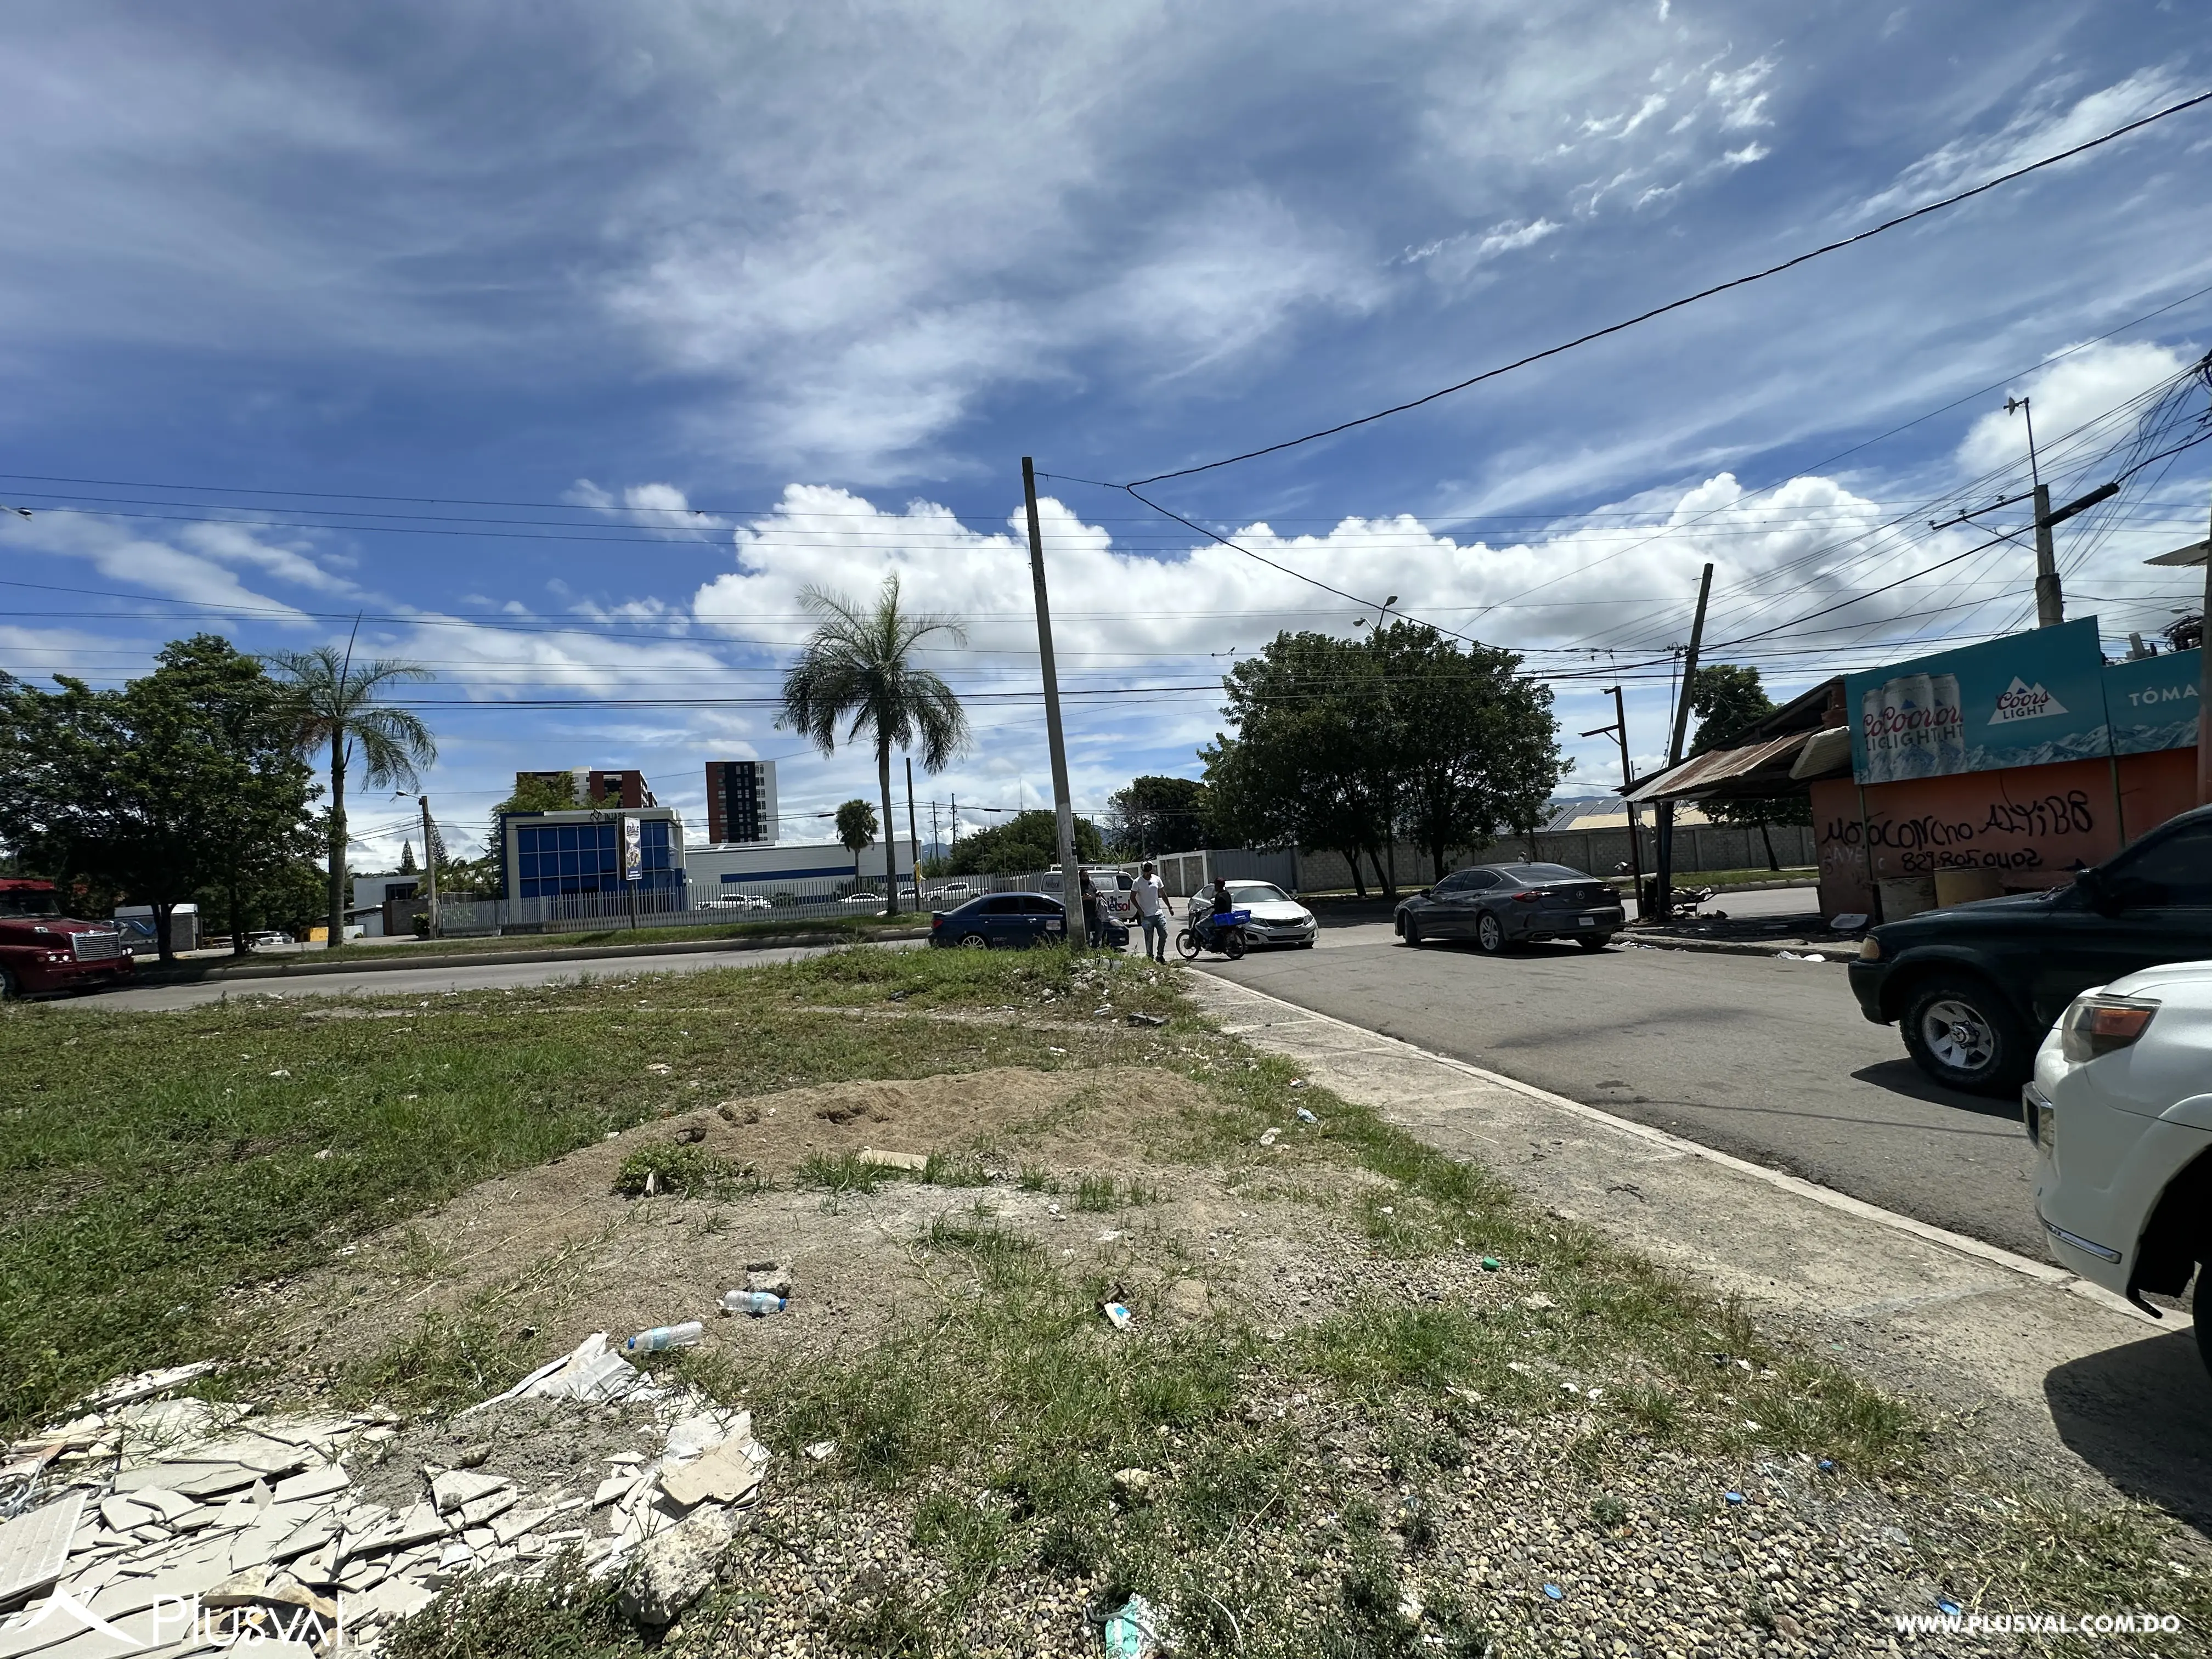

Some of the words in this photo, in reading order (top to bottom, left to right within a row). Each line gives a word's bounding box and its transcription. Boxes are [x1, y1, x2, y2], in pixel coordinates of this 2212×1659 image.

[1996, 690, 2051, 710] Coors
[2129, 684, 2199, 707] TÓMA
[2003, 704, 2045, 719] LIGHT
